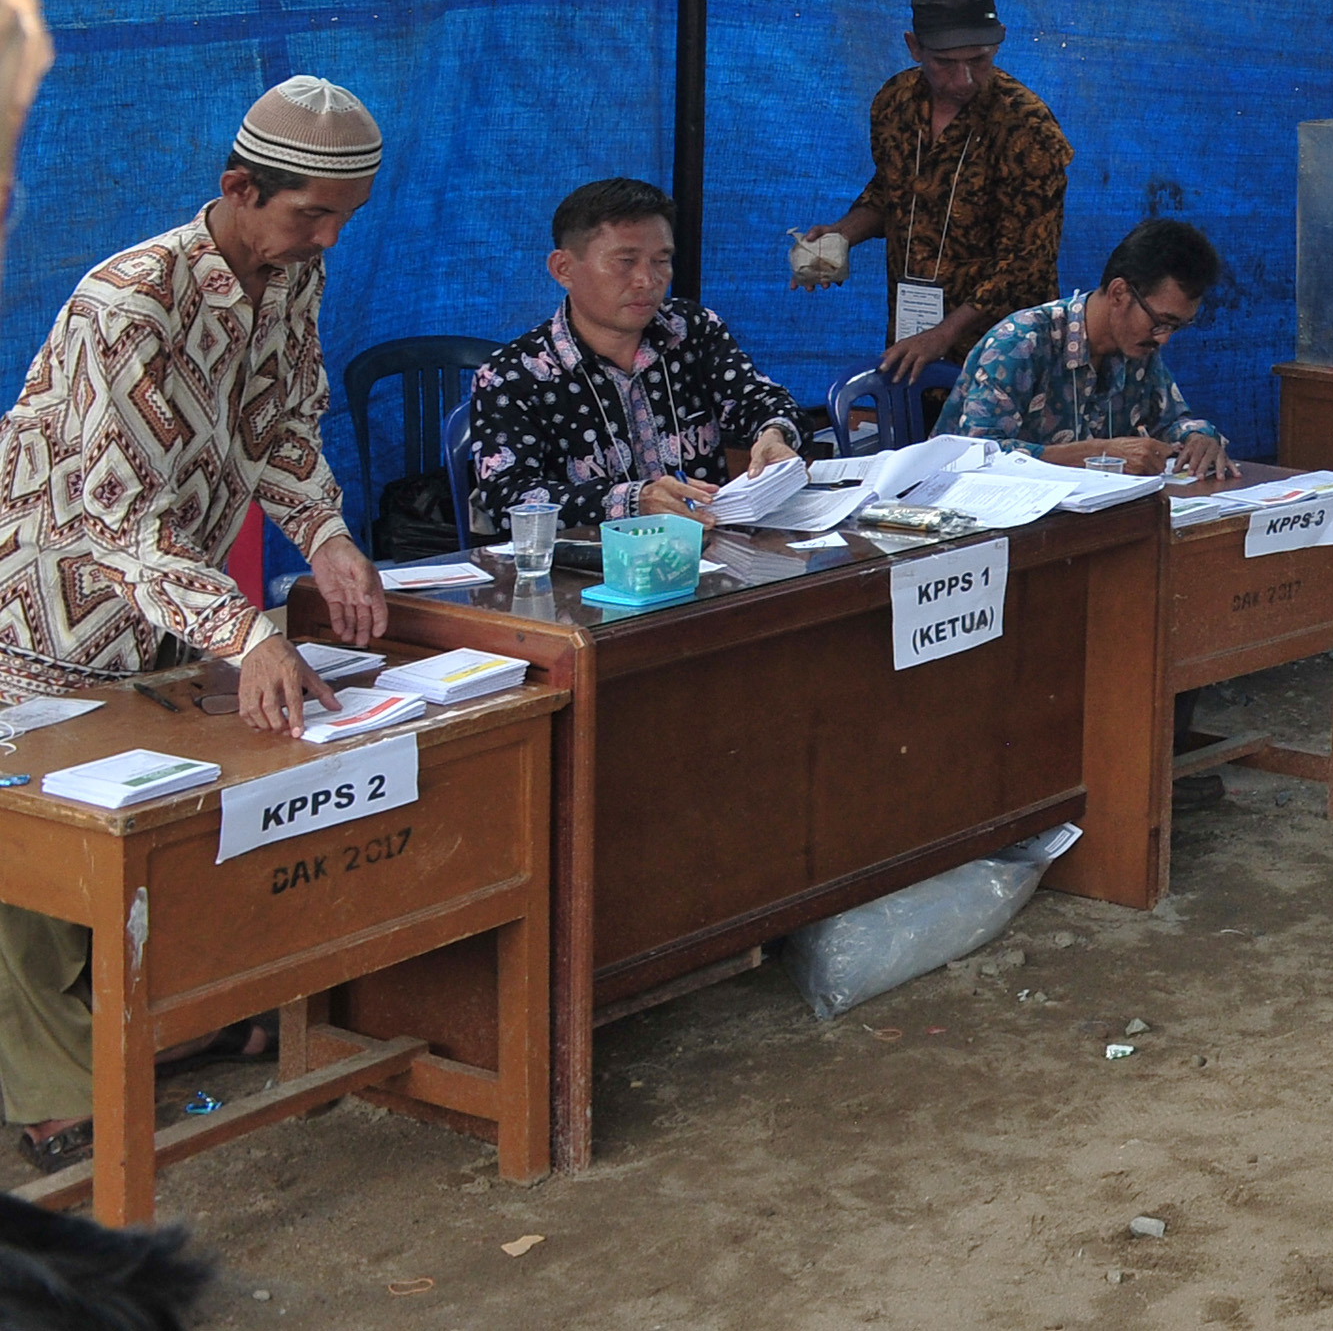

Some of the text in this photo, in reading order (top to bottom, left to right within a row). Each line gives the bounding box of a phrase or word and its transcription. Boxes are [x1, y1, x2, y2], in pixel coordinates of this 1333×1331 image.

[1266, 510, 1325, 535] KPPS 3
[917, 566, 989, 605] KPPS 1
[912, 606, 995, 655] (KETUA)
[262, 775, 386, 831] KPPS 2
[272, 827, 412, 895] DAK 2017
